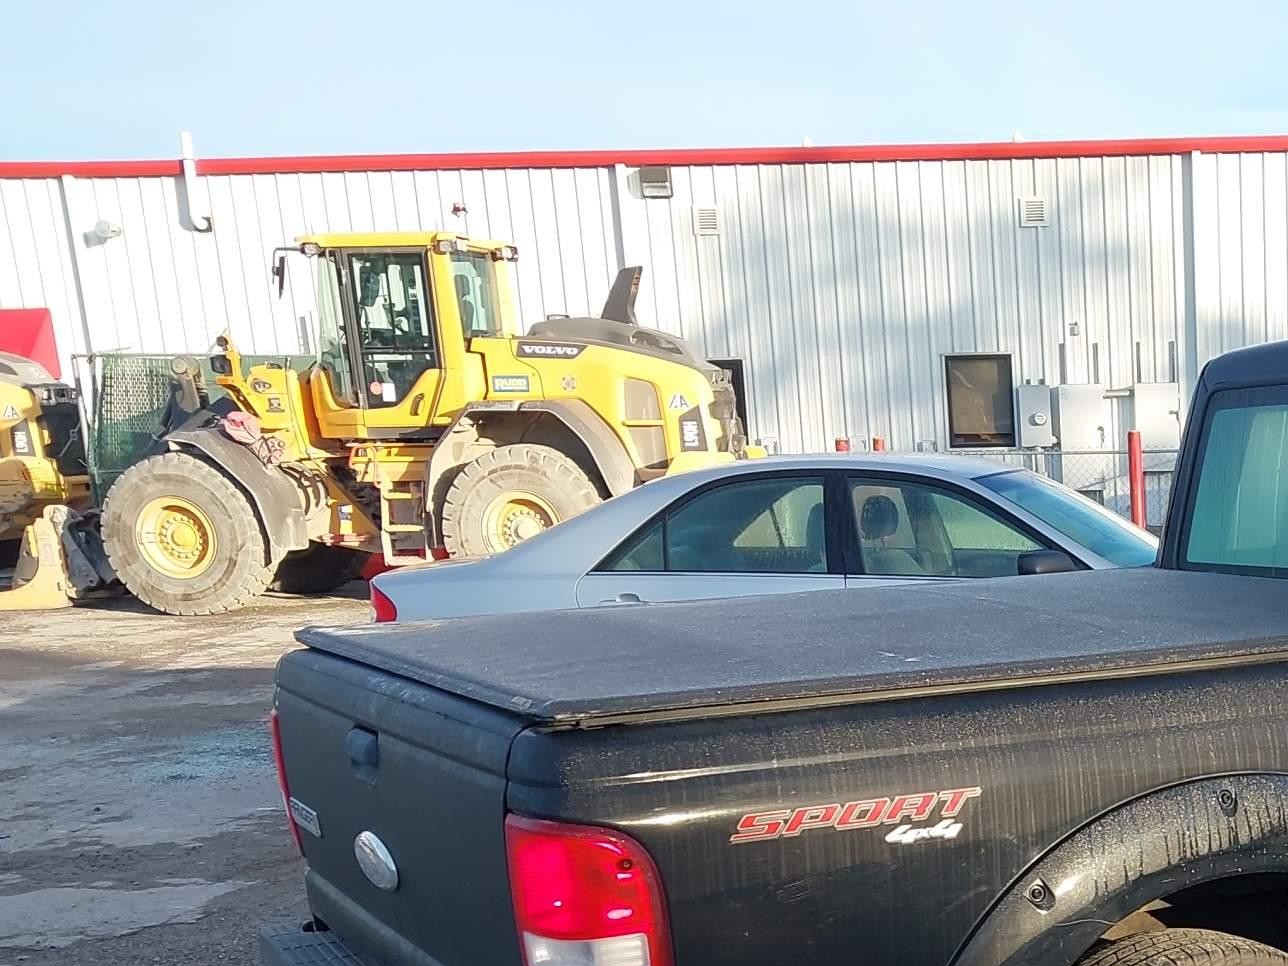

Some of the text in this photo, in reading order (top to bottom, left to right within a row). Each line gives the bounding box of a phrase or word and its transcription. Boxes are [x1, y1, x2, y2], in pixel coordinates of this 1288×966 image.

[521, 344, 579, 356] VOLVO
[494, 378, 528, 391] RUDD
[729, 786, 983, 844] SPORT
[885, 818, 964, 844] 4x4
